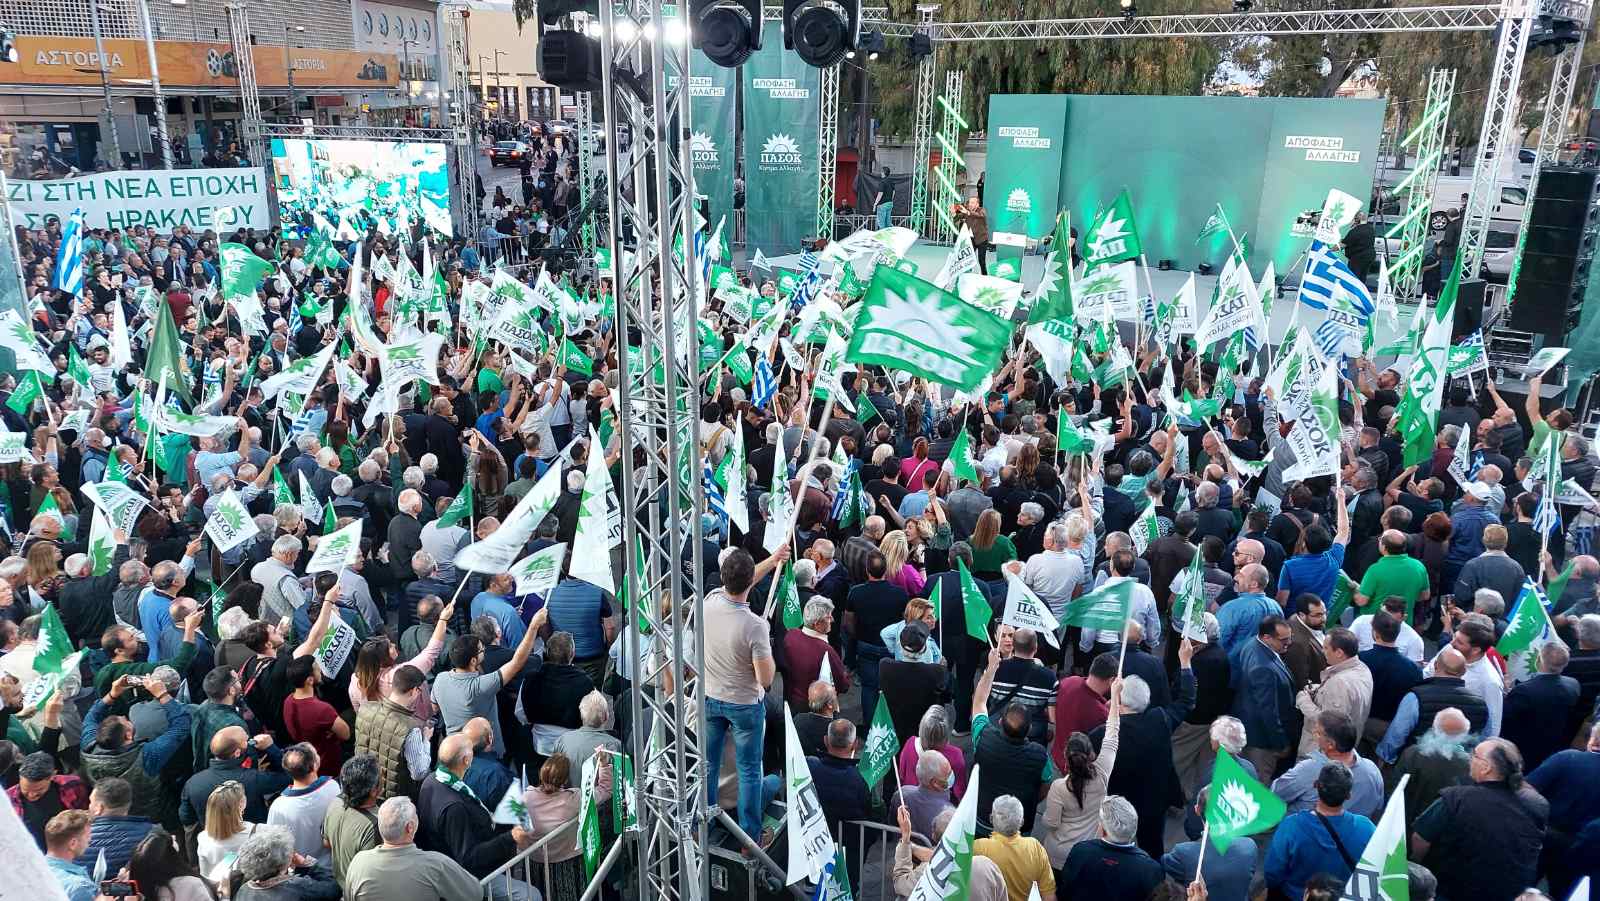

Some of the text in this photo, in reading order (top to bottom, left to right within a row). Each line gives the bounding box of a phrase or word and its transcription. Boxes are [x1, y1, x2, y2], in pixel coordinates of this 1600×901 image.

[35, 50, 123, 67] ΑΣΤΟΡΙΑ
[754, 80, 795, 88] ΑΠΟΦΑΣΗ
[771, 90, 808, 98] ΑΛΛΑΓΗΣ
[1287, 138, 1341, 147] ΑΠΟΦΑΣΗ
[760, 154, 801, 163] ΠΑΣΟΚ
[1307, 152, 1357, 161] ΑΛΛΑΓΗΣ
[43, 180, 97, 201] ΣΤΗ
[104, 177, 162, 199] ΝΕΑ
[169, 174, 259, 197] ΕΠΟΧΗ
[106, 205, 254, 232] ΗΡΑΚΛΕΟΥ
